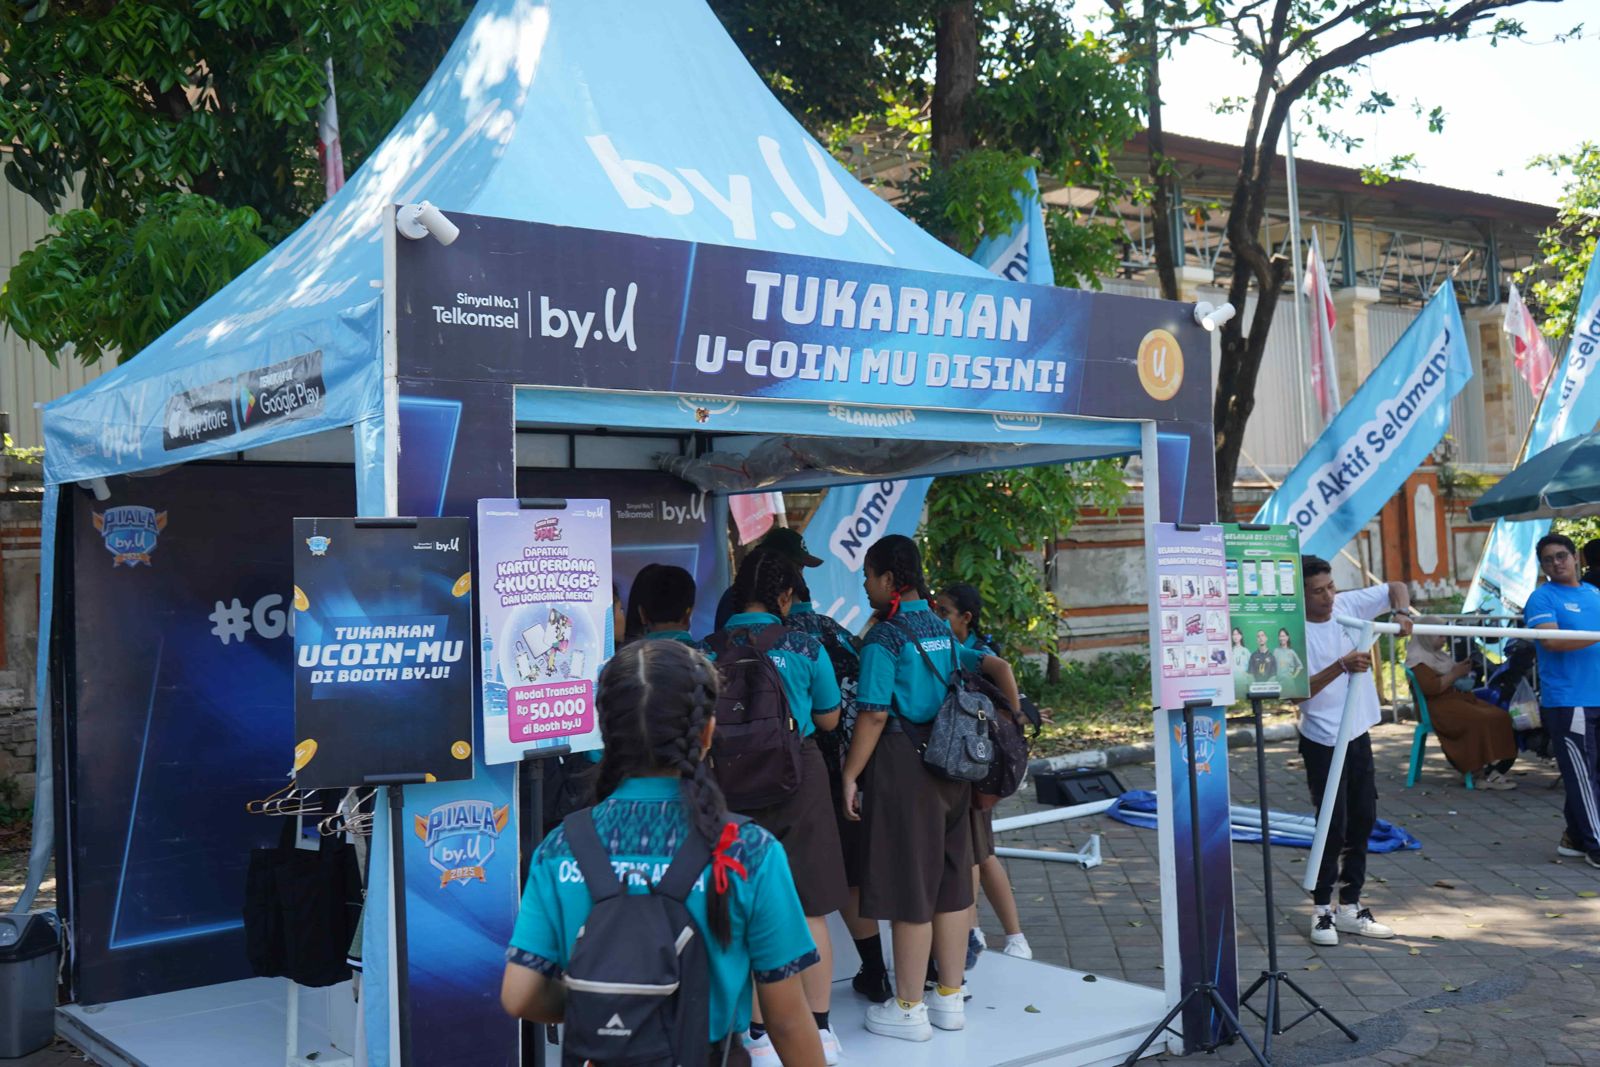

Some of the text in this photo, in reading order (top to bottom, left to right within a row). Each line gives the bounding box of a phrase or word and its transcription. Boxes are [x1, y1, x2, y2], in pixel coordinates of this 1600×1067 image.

[584, 134, 894, 255] by.U
[457, 292, 519, 309] Sinyal No.1
[745, 269, 1032, 342] TUKARKAN
[432, 305, 519, 329] Telkomsel
[540, 282, 638, 351] by.U
[694, 333, 1067, 394] U-COIN MU DISINI!
[259, 382, 319, 415] Google Play
[202, 409, 228, 431] Store
[827, 404, 916, 427] SELAMANYA
[1316, 446, 1372, 506] Aktif
[661, 493, 706, 524] by.U
[840, 480, 898, 559] Nomo
[103, 508, 159, 534] PIALA
[115, 531, 146, 549] by.U
[435, 537, 460, 552] by.U
[525, 546, 568, 558] DAPATKAN
[497, 559, 596, 576] KARTU PERDANA
[495, 574, 556, 593] +KUOTA
[502, 594, 520, 607] DAN
[566, 591, 593, 601] MERCH
[335, 624, 435, 640] TUKARKAN
[297, 640, 464, 667] UCOIN-MU
[310, 666, 450, 684] DI BOOTH BY.U!
[515, 684, 587, 702] Modal Transaksi
[516, 698, 586, 720] Rp 50.000
[522, 718, 581, 734] di Booth by.U
[427, 805, 497, 841] PIALA
[442, 834, 481, 864] by.U
[450, 867, 476, 880] 2025
